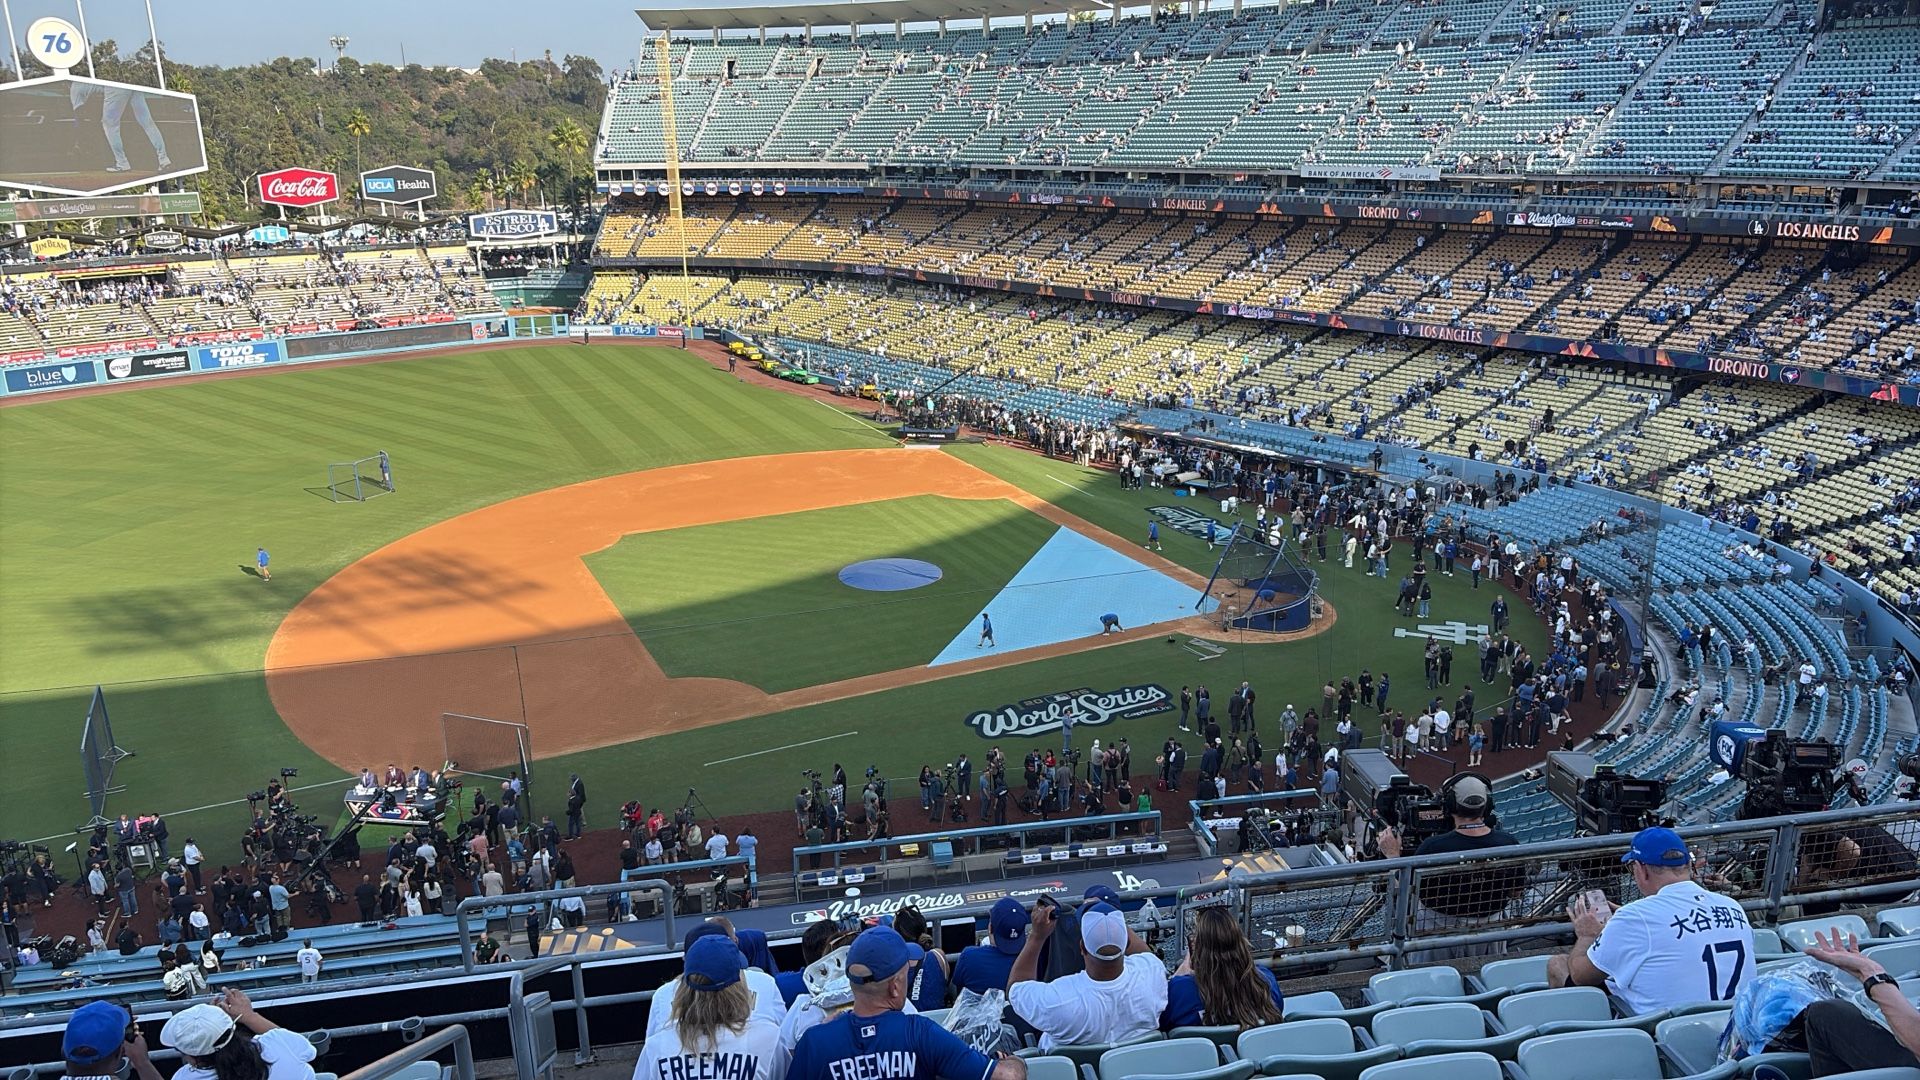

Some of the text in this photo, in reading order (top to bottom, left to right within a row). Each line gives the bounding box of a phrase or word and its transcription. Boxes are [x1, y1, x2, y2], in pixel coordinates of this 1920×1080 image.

[42, 33, 72, 53] 76
[1415, 172, 1432, 180] Level
[368, 179, 430, 190] UCLA Health
[1163, 199, 1207, 210] LOS ANGELES
[1358, 206, 1399, 219] TORONTO
[1528, 212, 1553, 225] World
[1553, 213, 1576, 226] Series
[480, 224, 535, 235] JALISCO
[1777, 222, 1860, 241] LOS ANGELES
[34, 240, 68, 254] JIM BEAM
[975, 277, 998, 288] ANGELES
[1110, 291, 1142, 305] TORONTO
[474, 327, 485, 336] 76
[1419, 325, 1483, 344] LOS ANGELES
[210, 345, 254, 358] TOYO
[111, 363, 130, 371] smart
[219, 354, 266, 366] TIRES
[1708, 357, 1769, 379] TORONTO
[27, 370, 61, 383] blue
[972, 686, 1167, 737] World Series
[1112, 870, 1143, 891] LA
[828, 889, 1007, 921] World Series 2025
[1670, 906, 1747, 939] 大谷翔平
[1702, 940, 1745, 1000] 17
[911, 968, 924, 1000] DODGERS
[658, 1052, 758, 1080] FREEMAN
[829, 1051, 917, 1080] FREEMAN
